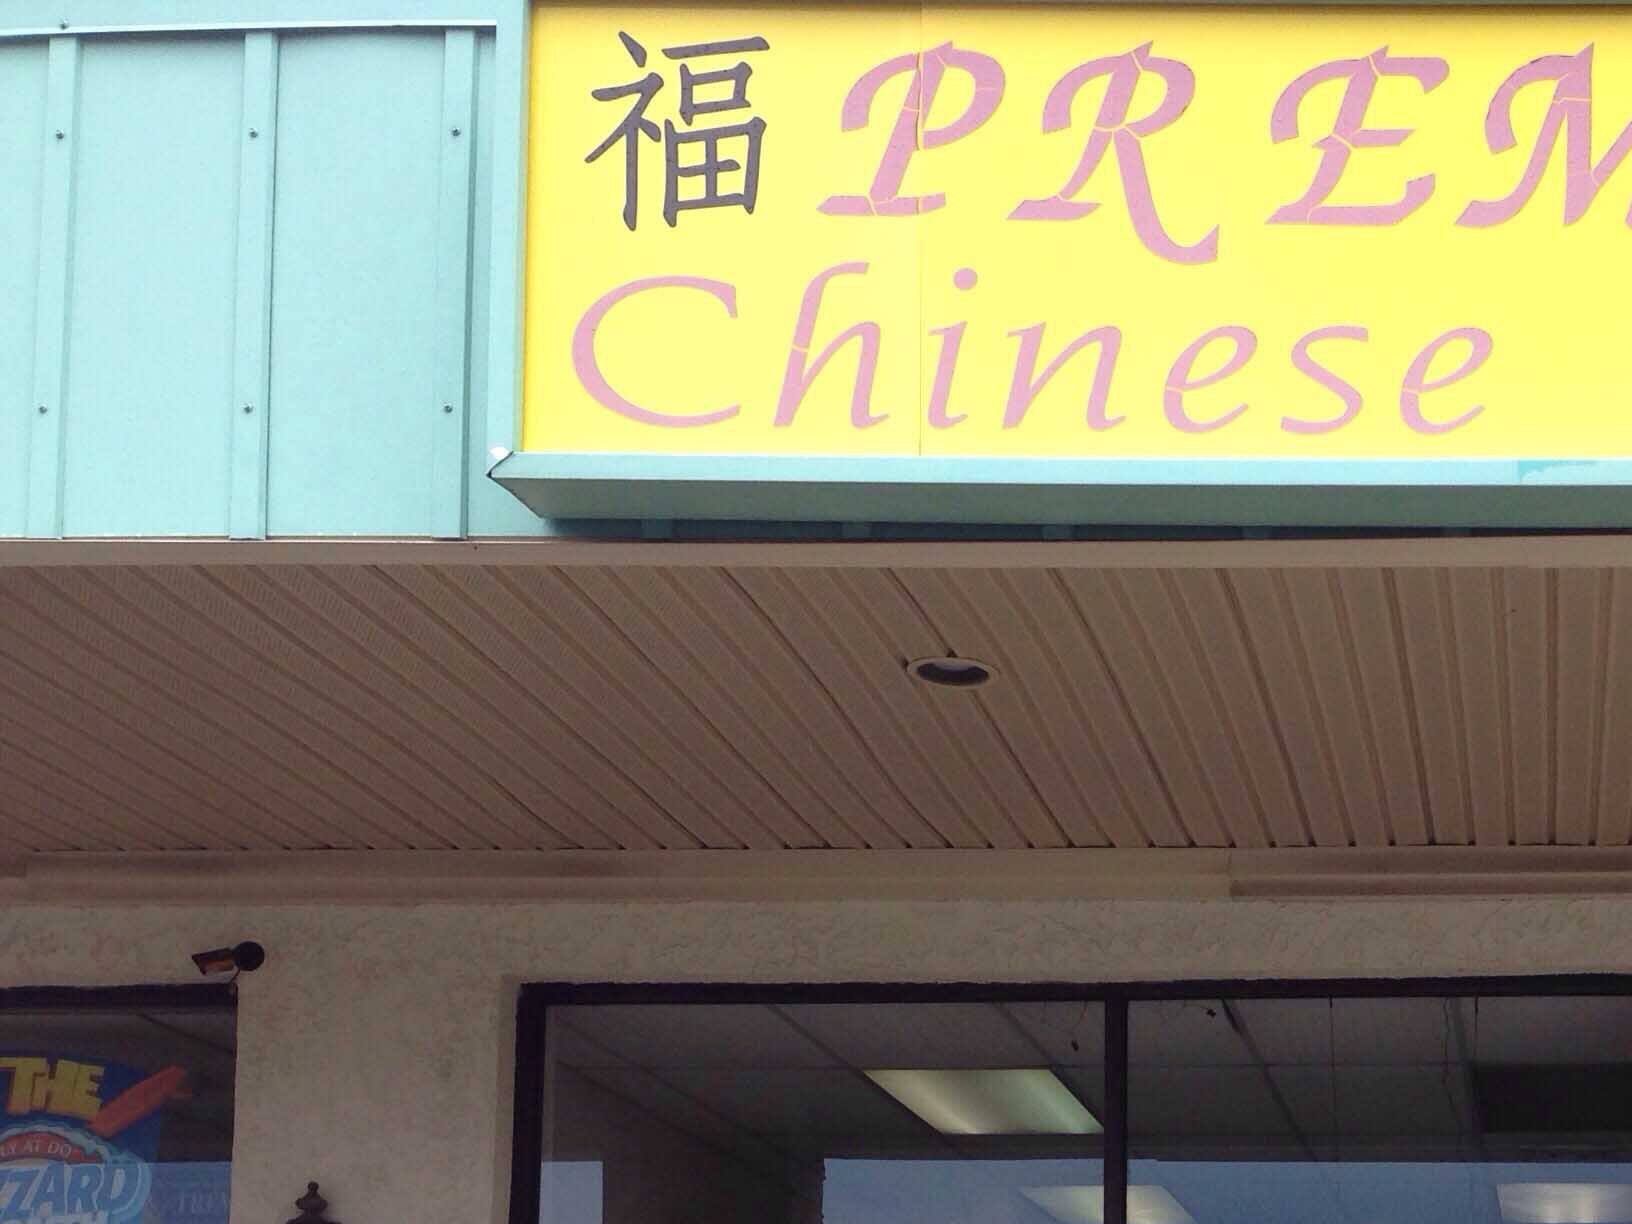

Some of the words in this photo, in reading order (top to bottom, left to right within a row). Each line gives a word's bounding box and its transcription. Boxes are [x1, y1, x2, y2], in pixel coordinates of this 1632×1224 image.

[585, 31, 770, 232] 福
[571, 262, 1493, 435] Chinese
[0, 1057, 105, 1123] THE
